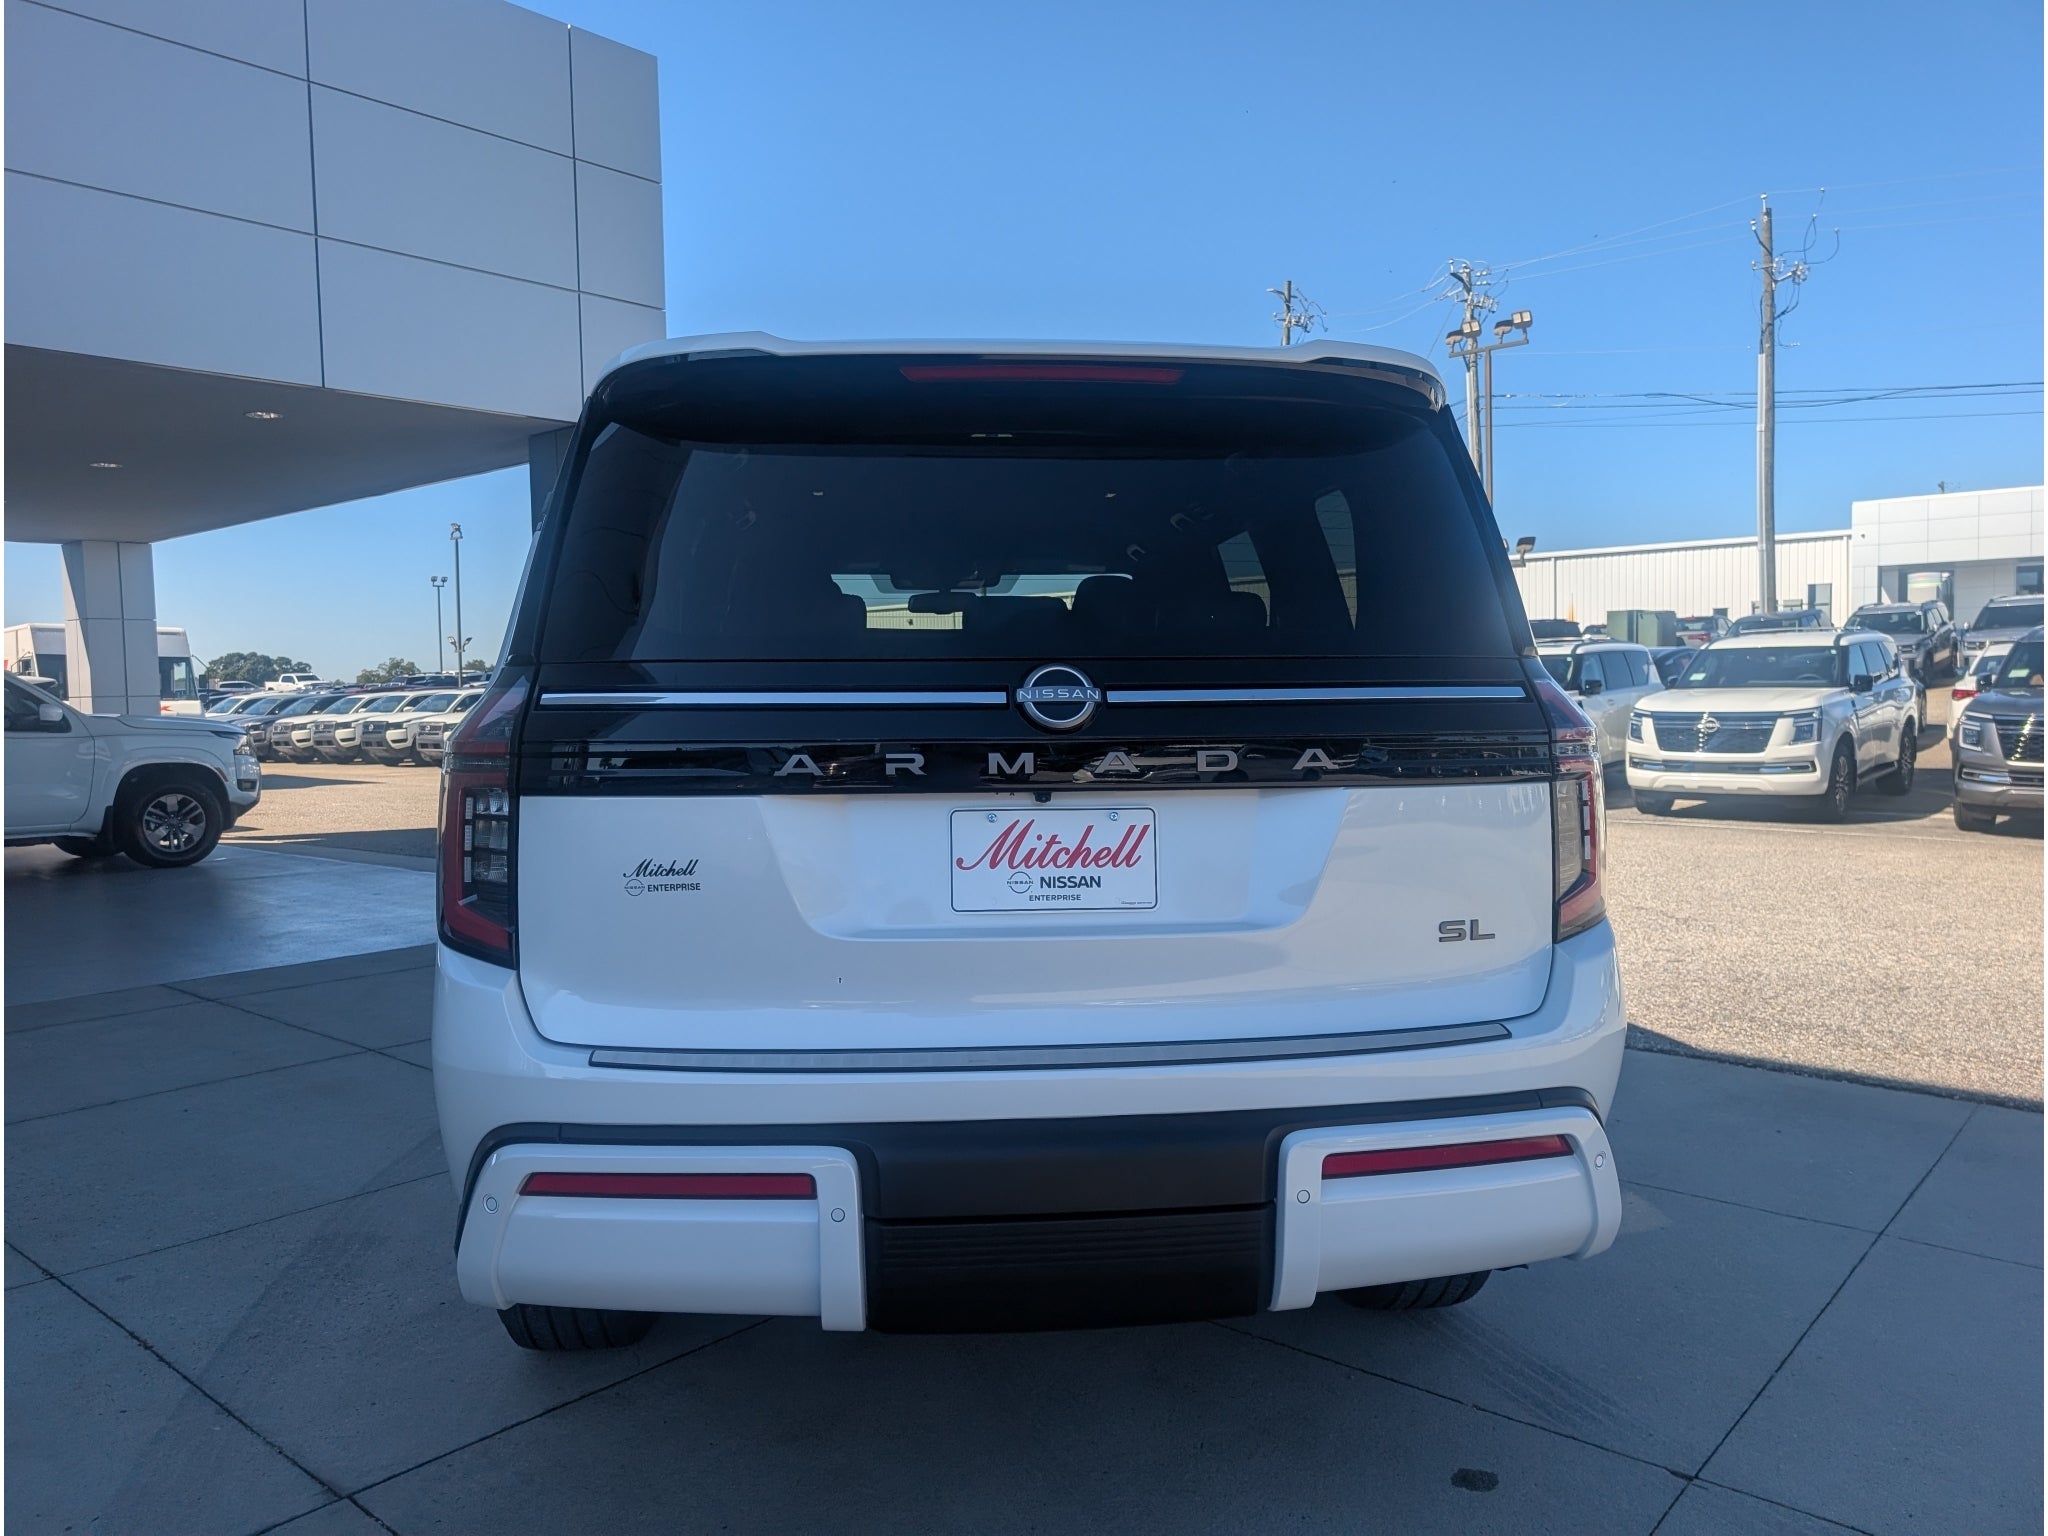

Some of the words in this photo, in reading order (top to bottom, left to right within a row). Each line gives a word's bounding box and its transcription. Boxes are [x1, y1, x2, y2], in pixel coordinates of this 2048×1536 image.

[1019, 688, 1099, 700] NISSAN
[773, 748, 1339, 776] ARMADA
[956, 818, 1151, 871] Mitchell
[623, 858, 699, 878] Mitchell
[647, 883, 701, 892] ENTERPRISE
[1039, 875, 1102, 889] NISSAN
[1028, 894, 1082, 902] ENTERPRISE
[1438, 918, 1496, 943] SL
